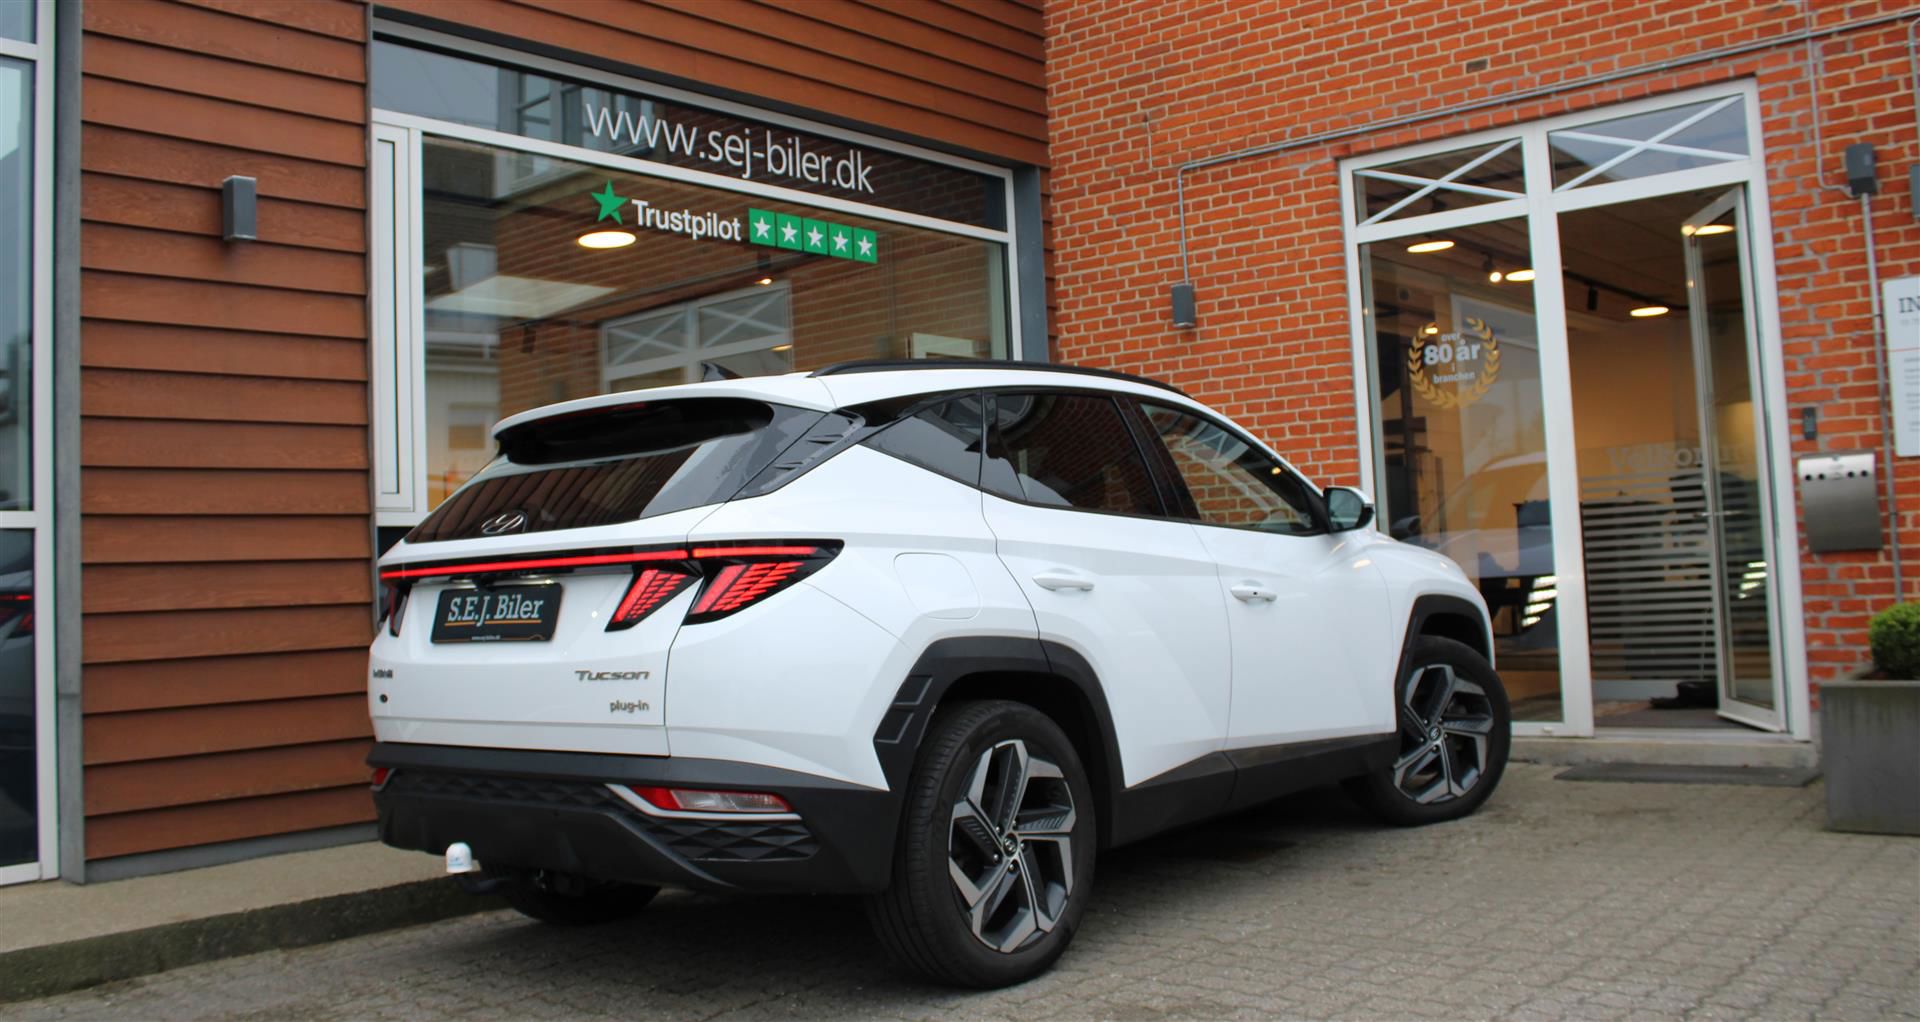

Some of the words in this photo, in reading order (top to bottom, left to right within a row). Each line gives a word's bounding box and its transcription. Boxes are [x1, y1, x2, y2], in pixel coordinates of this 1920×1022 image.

[586, 102, 875, 194] www.sej-biler.dk
[631, 198, 742, 242] Trustpilot
[1424, 344, 1453, 366] 80
[1456, 339, 1481, 361] år
[446, 595, 491, 628] S.E.J.
[493, 593, 544, 620] Biler
[609, 699, 650, 714] plug-in
